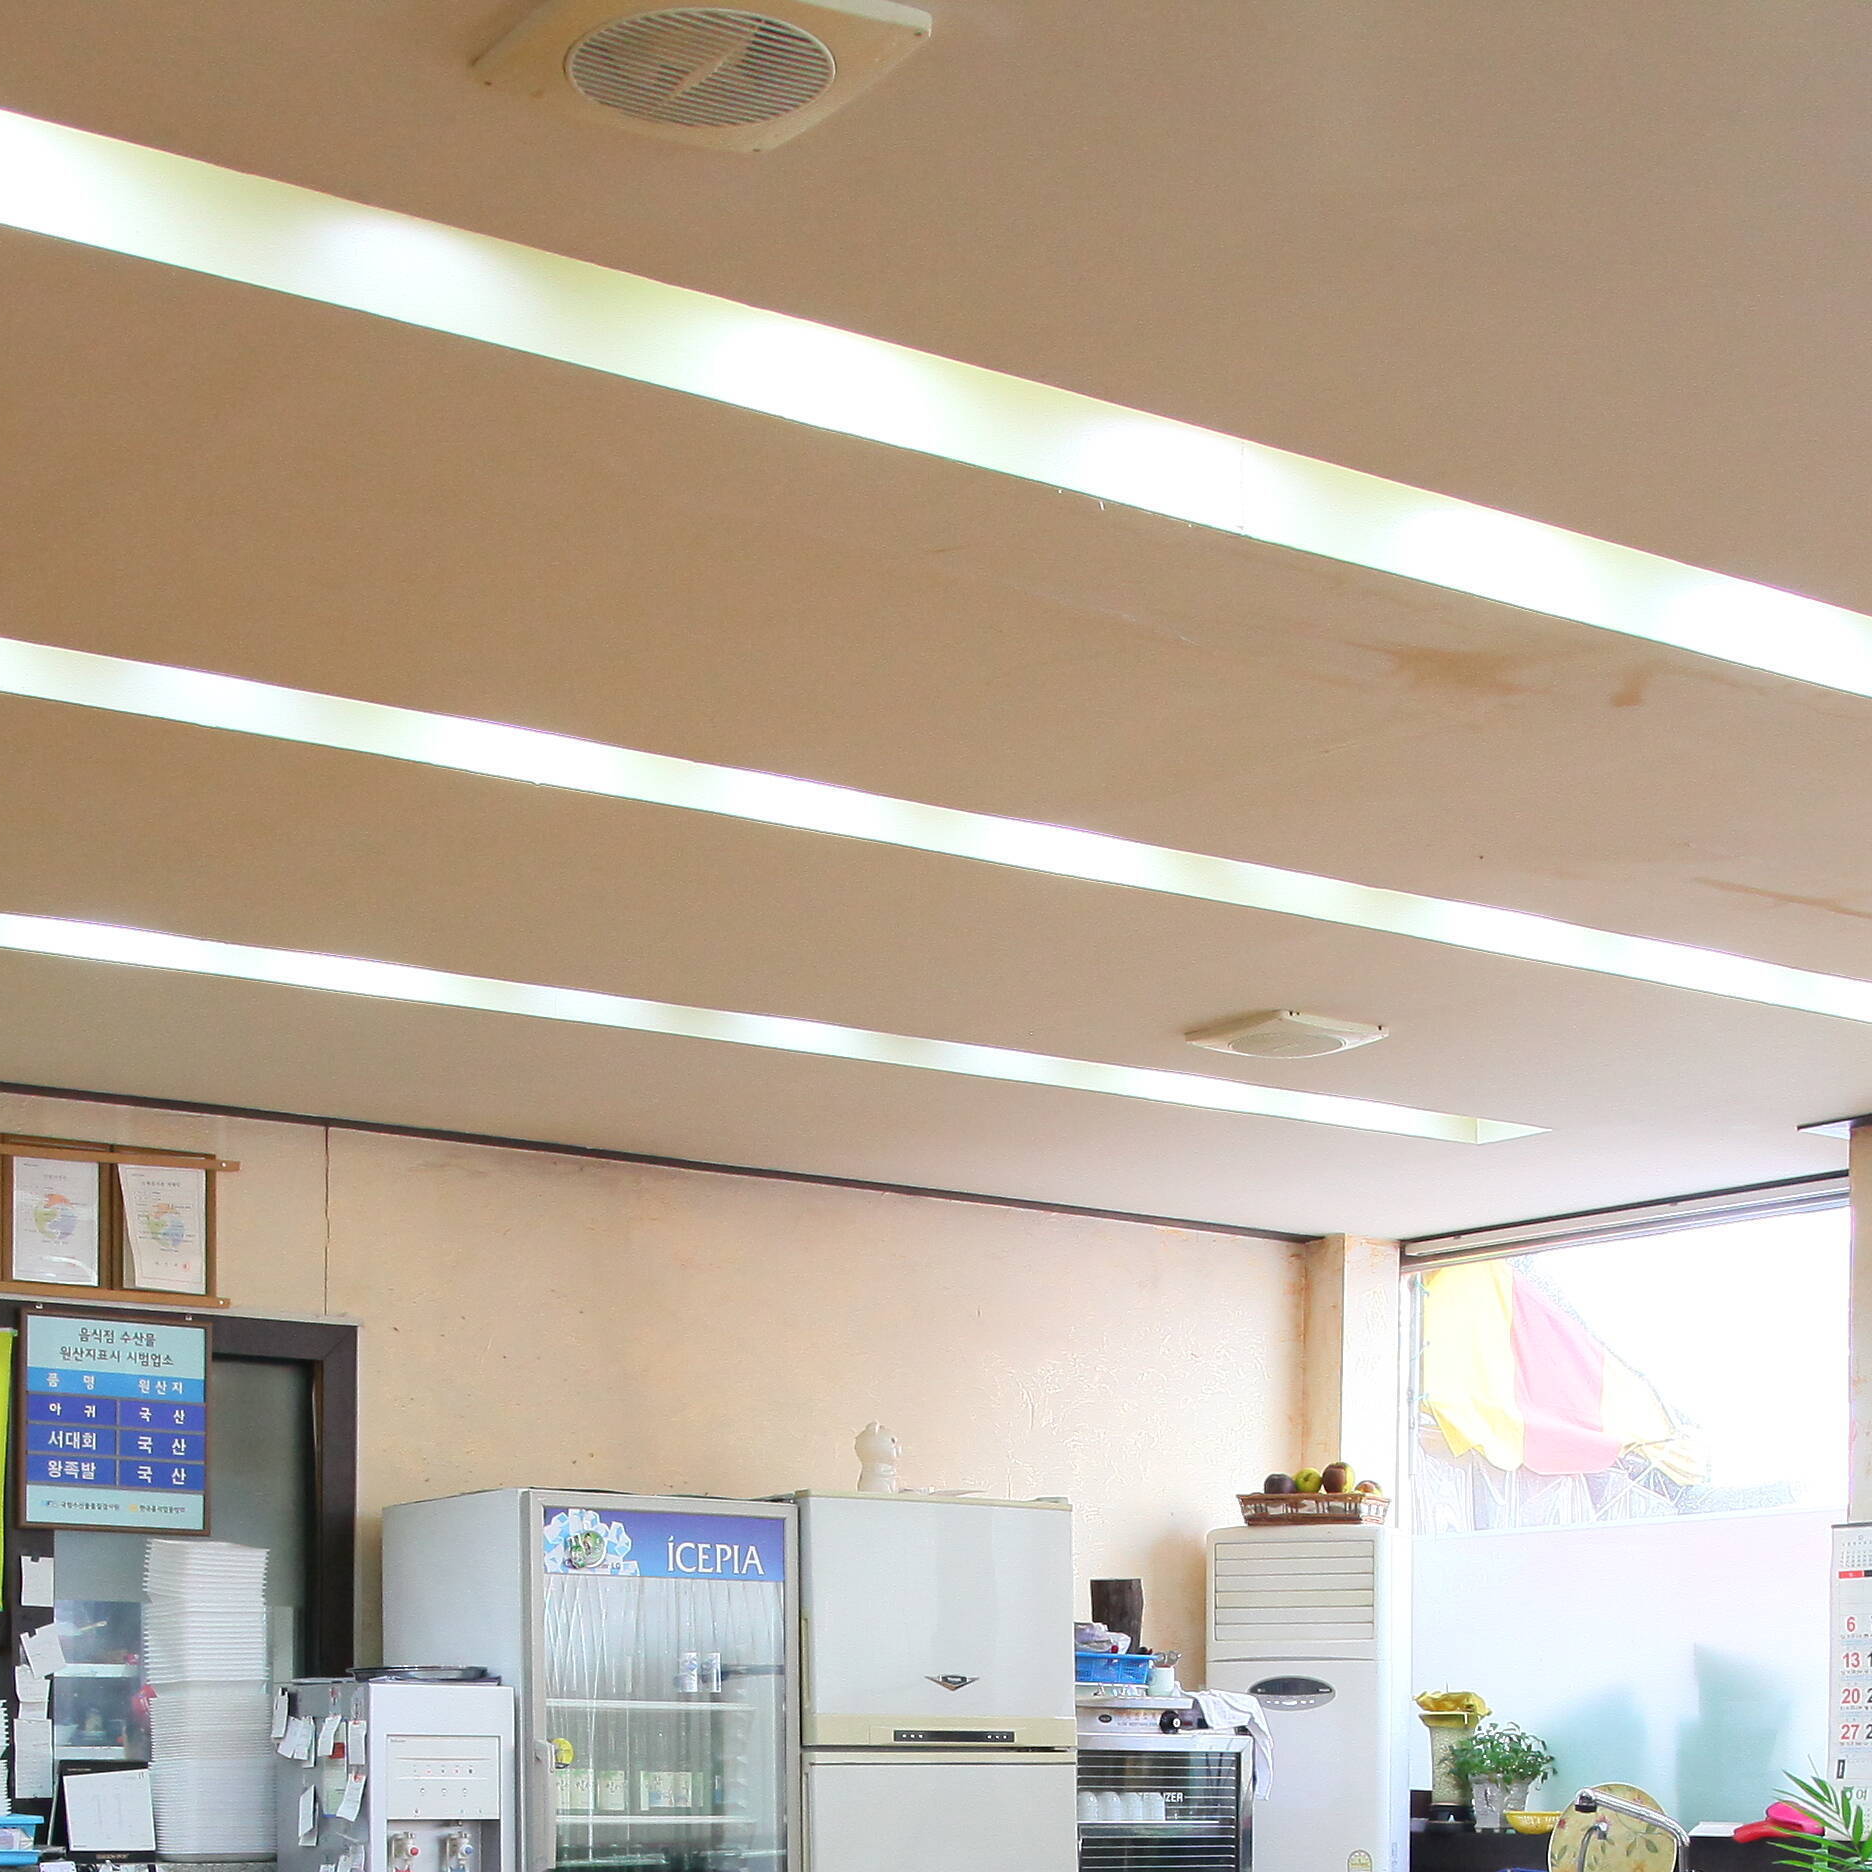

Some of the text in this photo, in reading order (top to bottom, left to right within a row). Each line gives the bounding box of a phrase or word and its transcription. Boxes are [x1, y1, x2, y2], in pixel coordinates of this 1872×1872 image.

[79, 1328, 156, 1347] 음식점 수산물
[60, 1346, 174, 1367] 원산지표시 시범업소
[48, 1431, 97, 1450] 서대회
[48, 1460, 96, 1480] 왕족발
[1846, 1616, 1856, 1632] 6
[1843, 1653, 1860, 1668] 13
[1841, 1688, 1860, 1704] 20
[1841, 1724, 1860, 1740] 27
